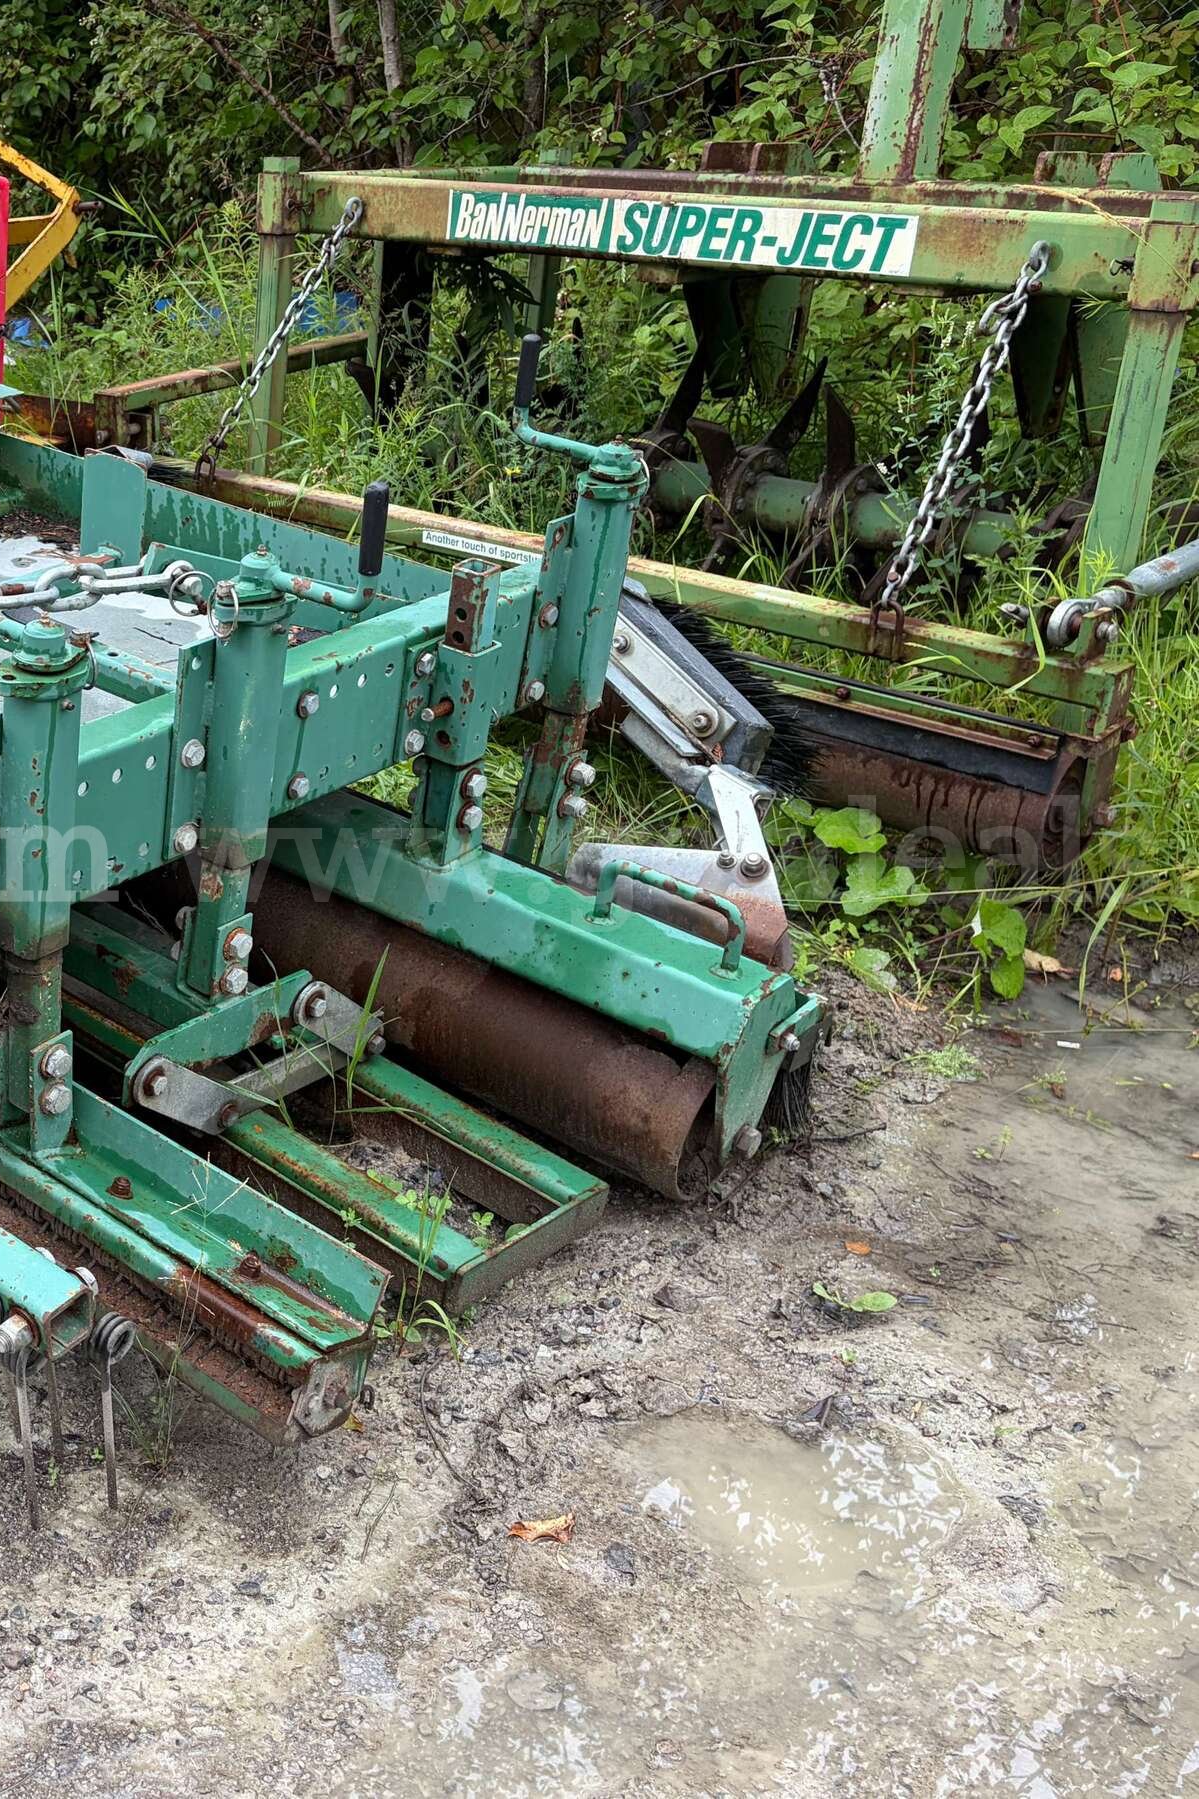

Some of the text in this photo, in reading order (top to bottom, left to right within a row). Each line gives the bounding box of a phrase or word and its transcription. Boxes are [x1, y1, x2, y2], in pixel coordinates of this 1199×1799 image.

[616, 202, 908, 274] SUPER-JECT
[426, 531, 460, 547] Another
[462, 540, 486, 553] touch
[489, 546, 498, 555] of
